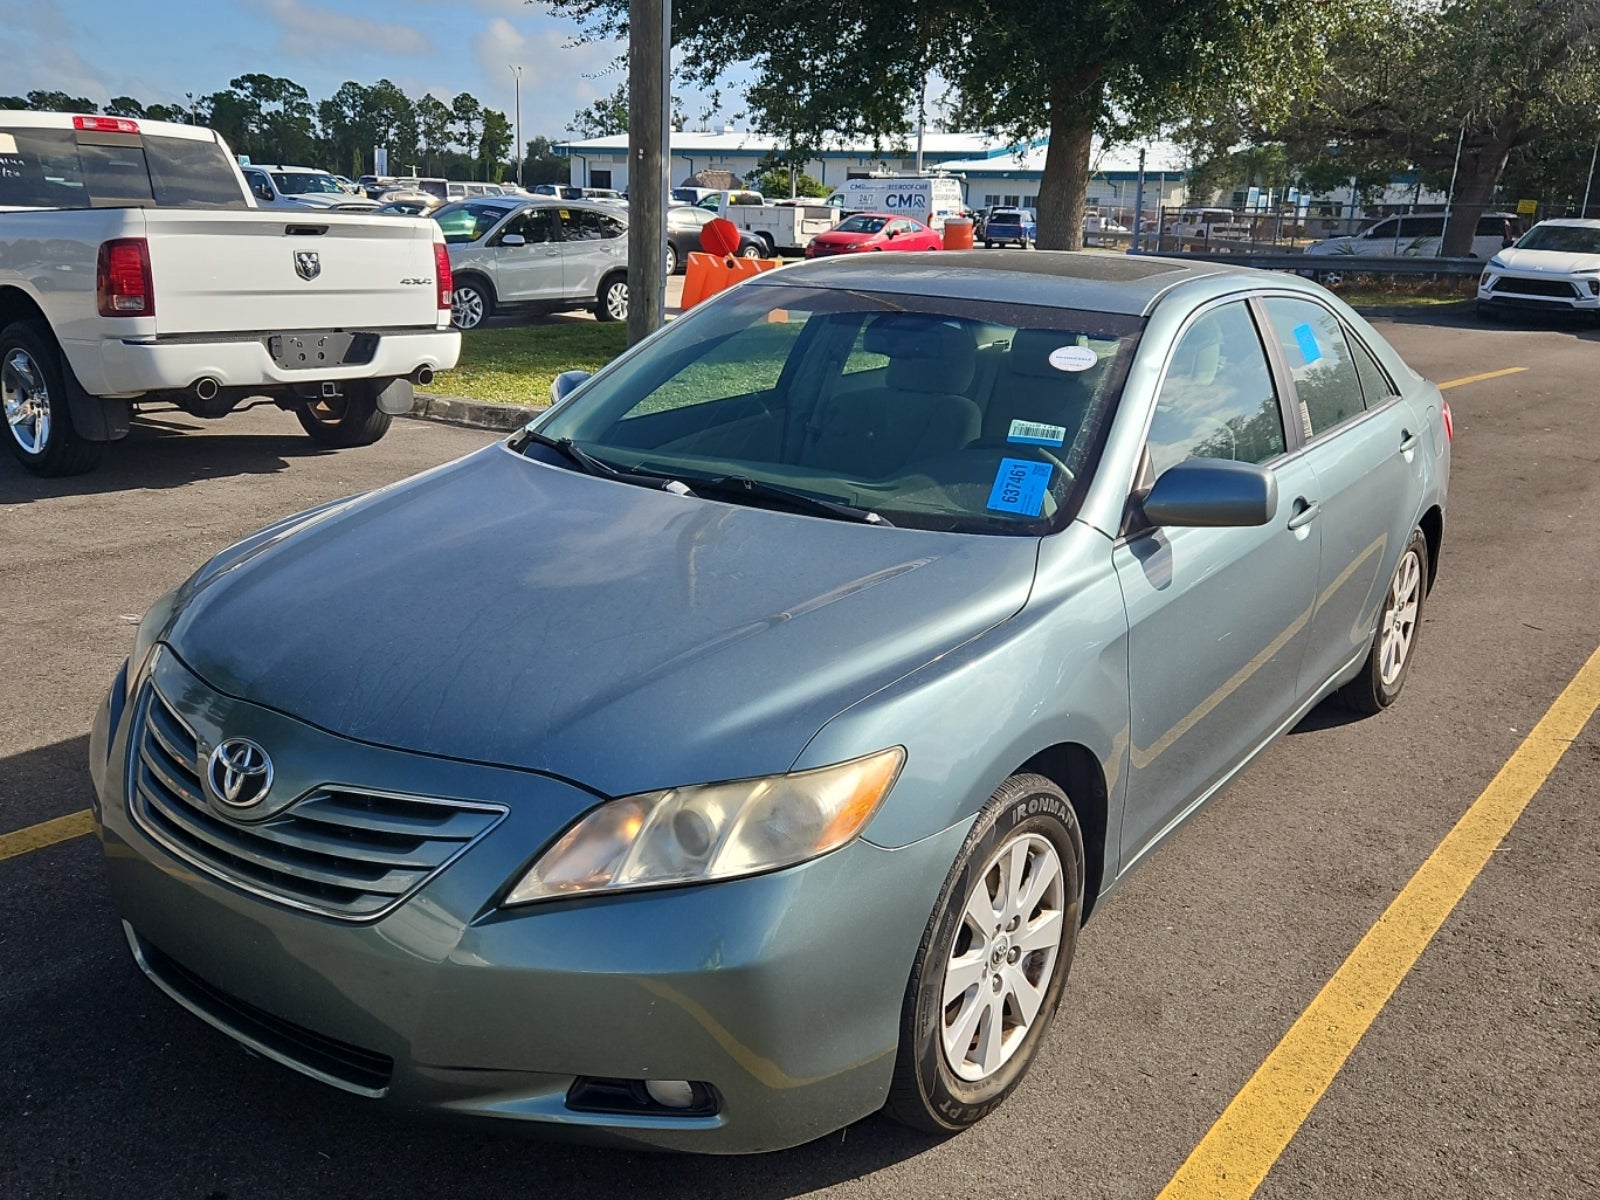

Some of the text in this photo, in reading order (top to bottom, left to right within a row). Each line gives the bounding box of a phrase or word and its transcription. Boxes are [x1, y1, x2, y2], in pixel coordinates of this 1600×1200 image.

[859, 194, 874, 202] 24/7
[885, 193, 926, 208] CMR
[1001, 464, 1028, 504] 637461
[1012, 797, 1074, 830] IRONMAN
